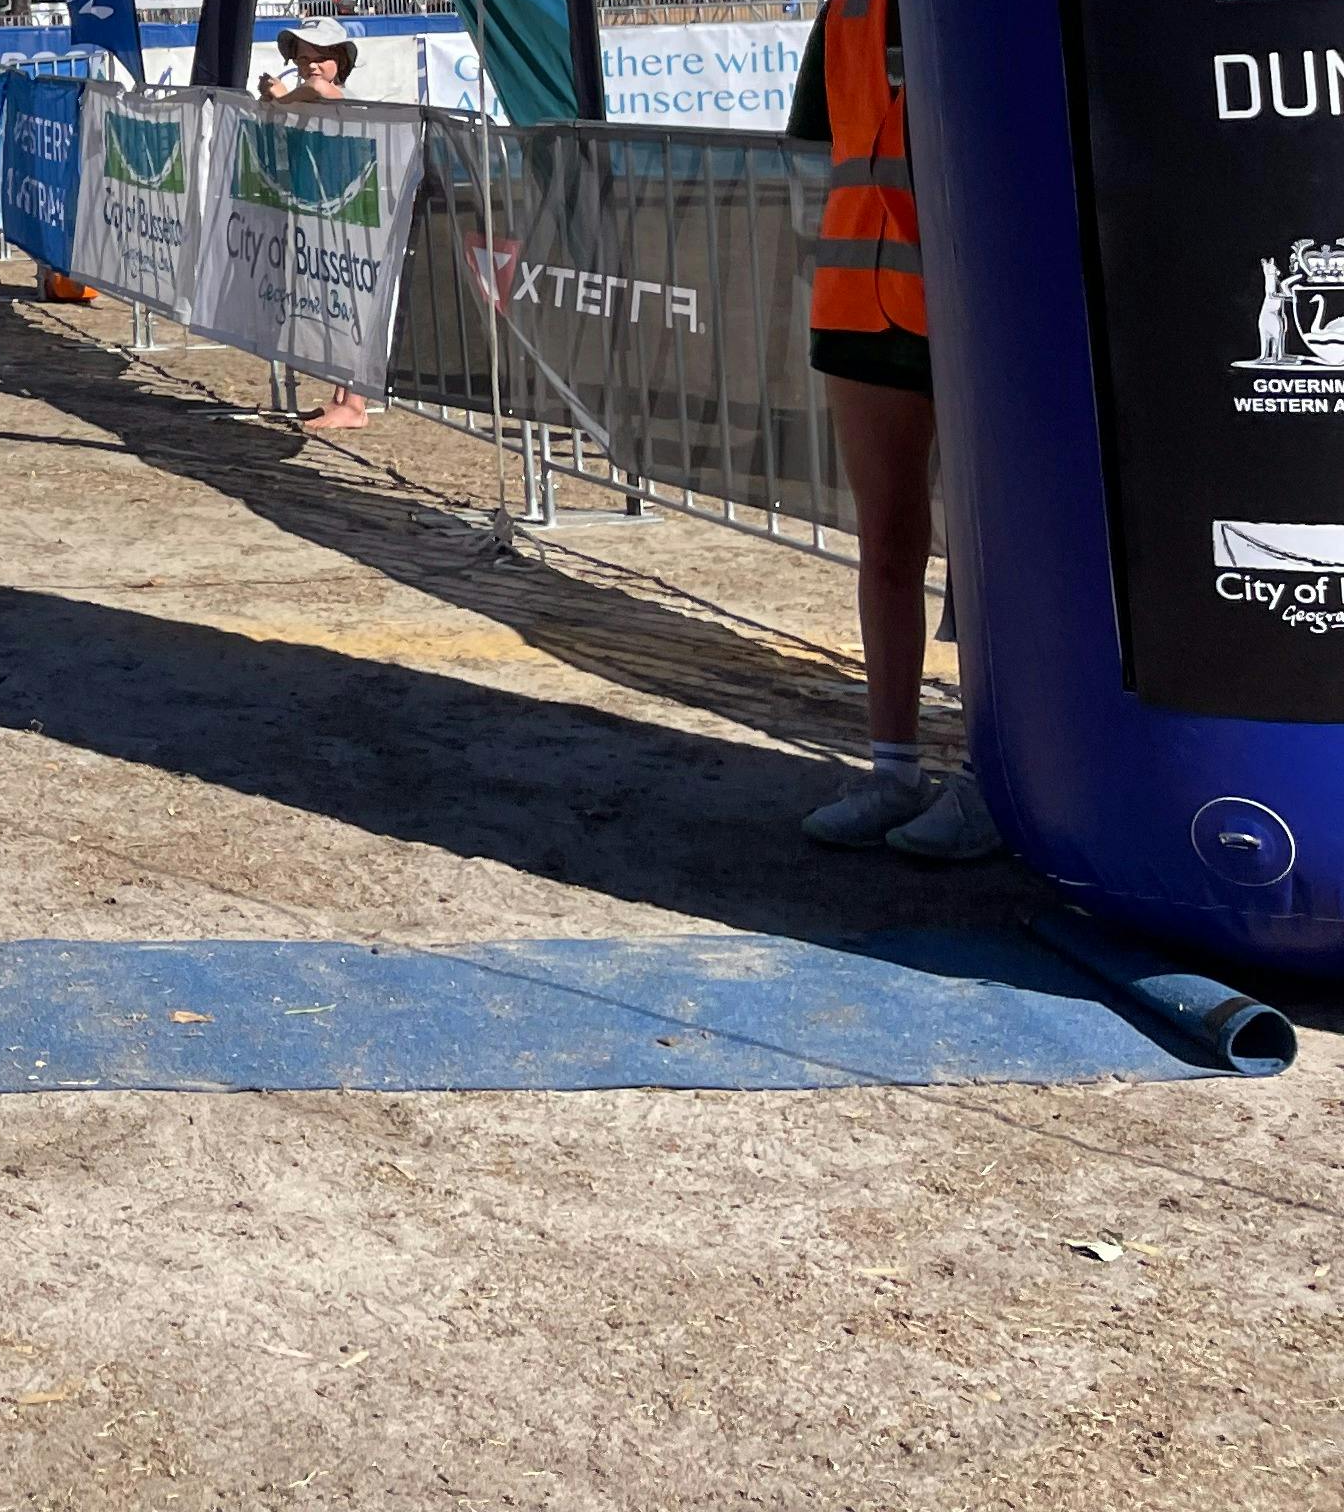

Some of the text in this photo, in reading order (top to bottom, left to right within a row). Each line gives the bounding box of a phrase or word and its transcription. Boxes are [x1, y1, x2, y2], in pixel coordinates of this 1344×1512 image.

[714, 41, 799, 75] with
[605, 83, 794, 116] unscreen
[226, 212, 265, 279] City
[1233, 396, 1329, 413] WESTERN
[1215, 572, 1286, 610] City
[1293, 576, 1330, 605] of
